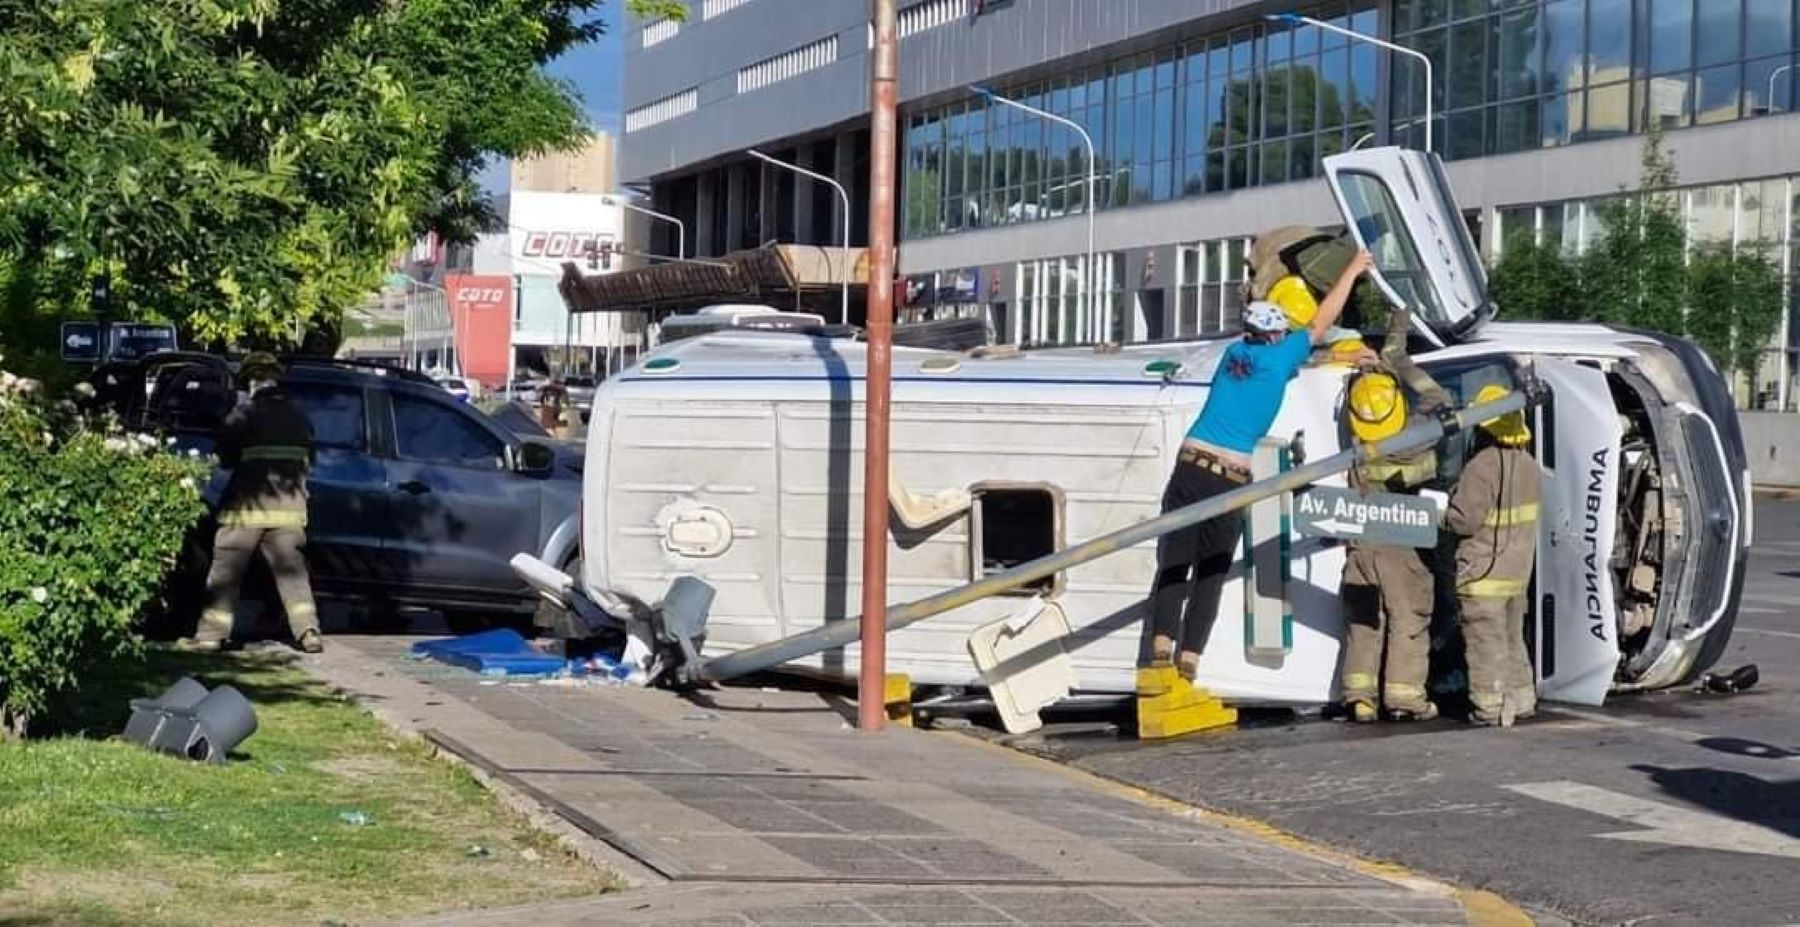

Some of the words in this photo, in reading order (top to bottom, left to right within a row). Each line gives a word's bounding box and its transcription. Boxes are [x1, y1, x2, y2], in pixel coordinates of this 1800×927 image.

[456, 287, 504, 302] COTO
[1300, 492, 1328, 514] Av.
[1333, 496, 1429, 527] Argentina
